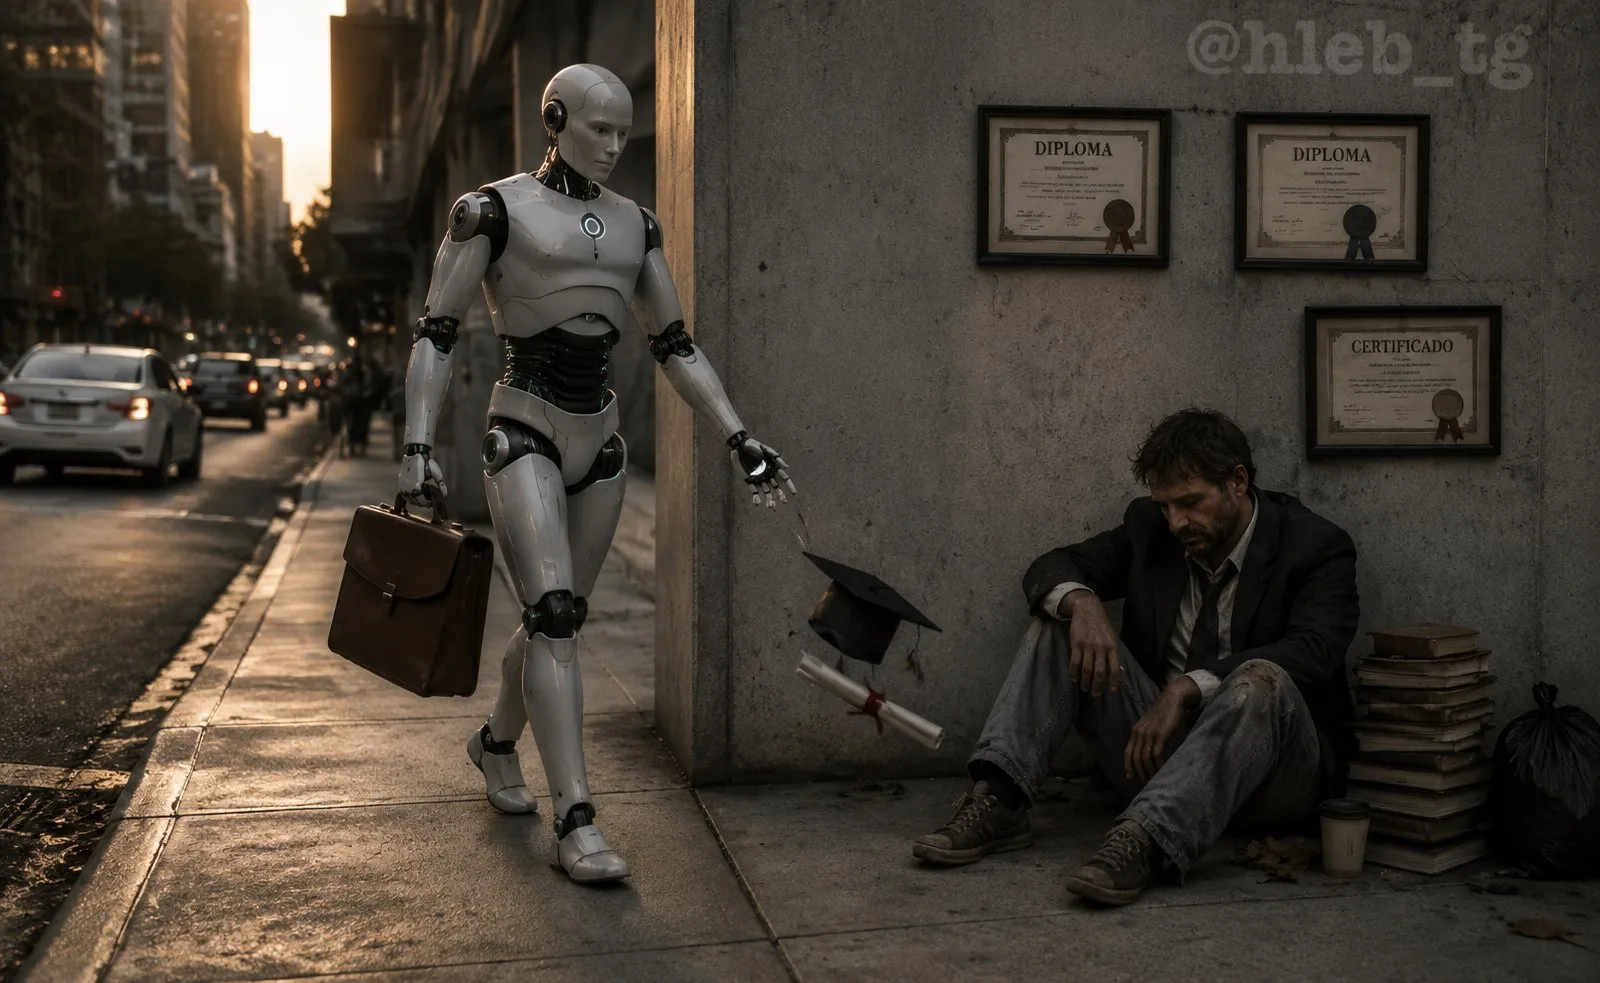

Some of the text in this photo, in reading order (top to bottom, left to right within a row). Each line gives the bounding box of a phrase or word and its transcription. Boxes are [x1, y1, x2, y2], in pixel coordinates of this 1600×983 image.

[1034, 141, 1113, 156] DIPLOMA
[1292, 147, 1372, 162] DIPLOMA
[1351, 339, 1454, 353] CERTIFICADO
